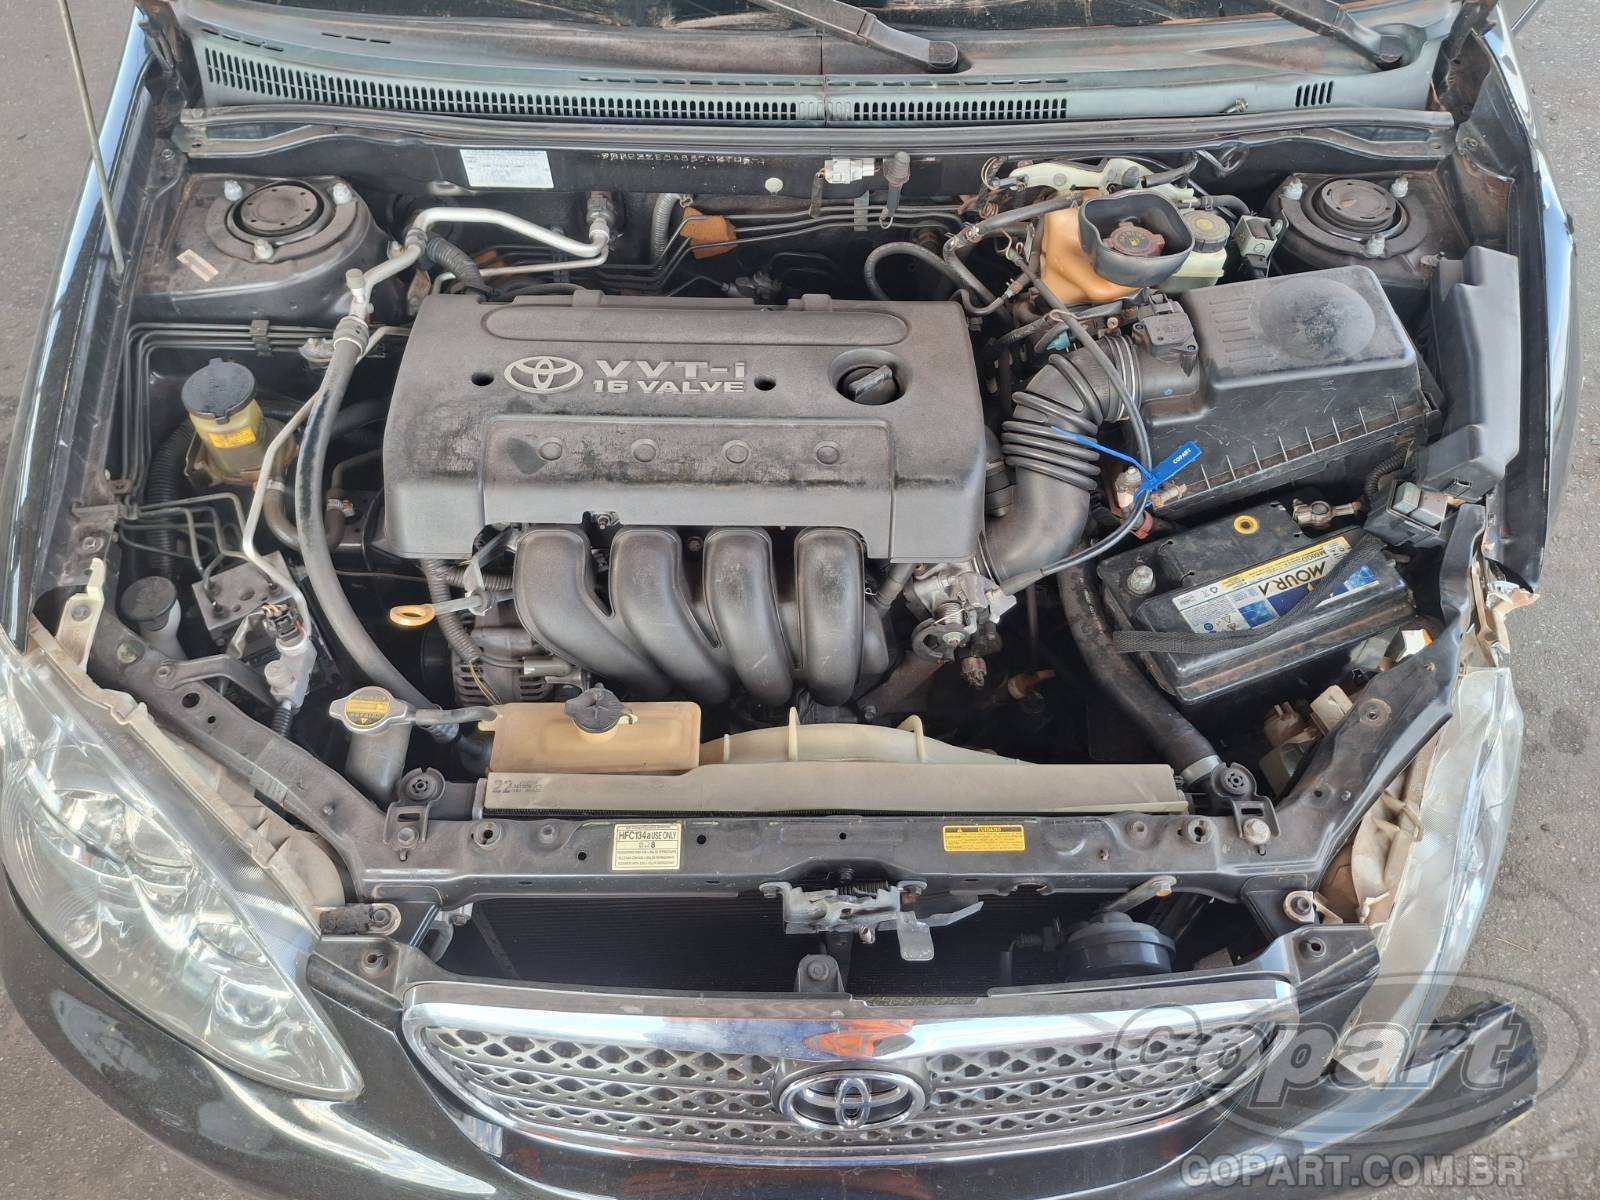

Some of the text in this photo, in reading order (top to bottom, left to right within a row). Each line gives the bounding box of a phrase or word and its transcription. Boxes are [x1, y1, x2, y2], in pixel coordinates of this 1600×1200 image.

[596, 360, 745, 378] VVT-i
[593, 379, 745, 395] 16 VALVE
[1172, 448, 1191, 464] COPART
[1258, 561, 1326, 596] MOURA
[492, 780, 512, 794] 22
[618, 831, 677, 840] HFC134a USE ONLY
